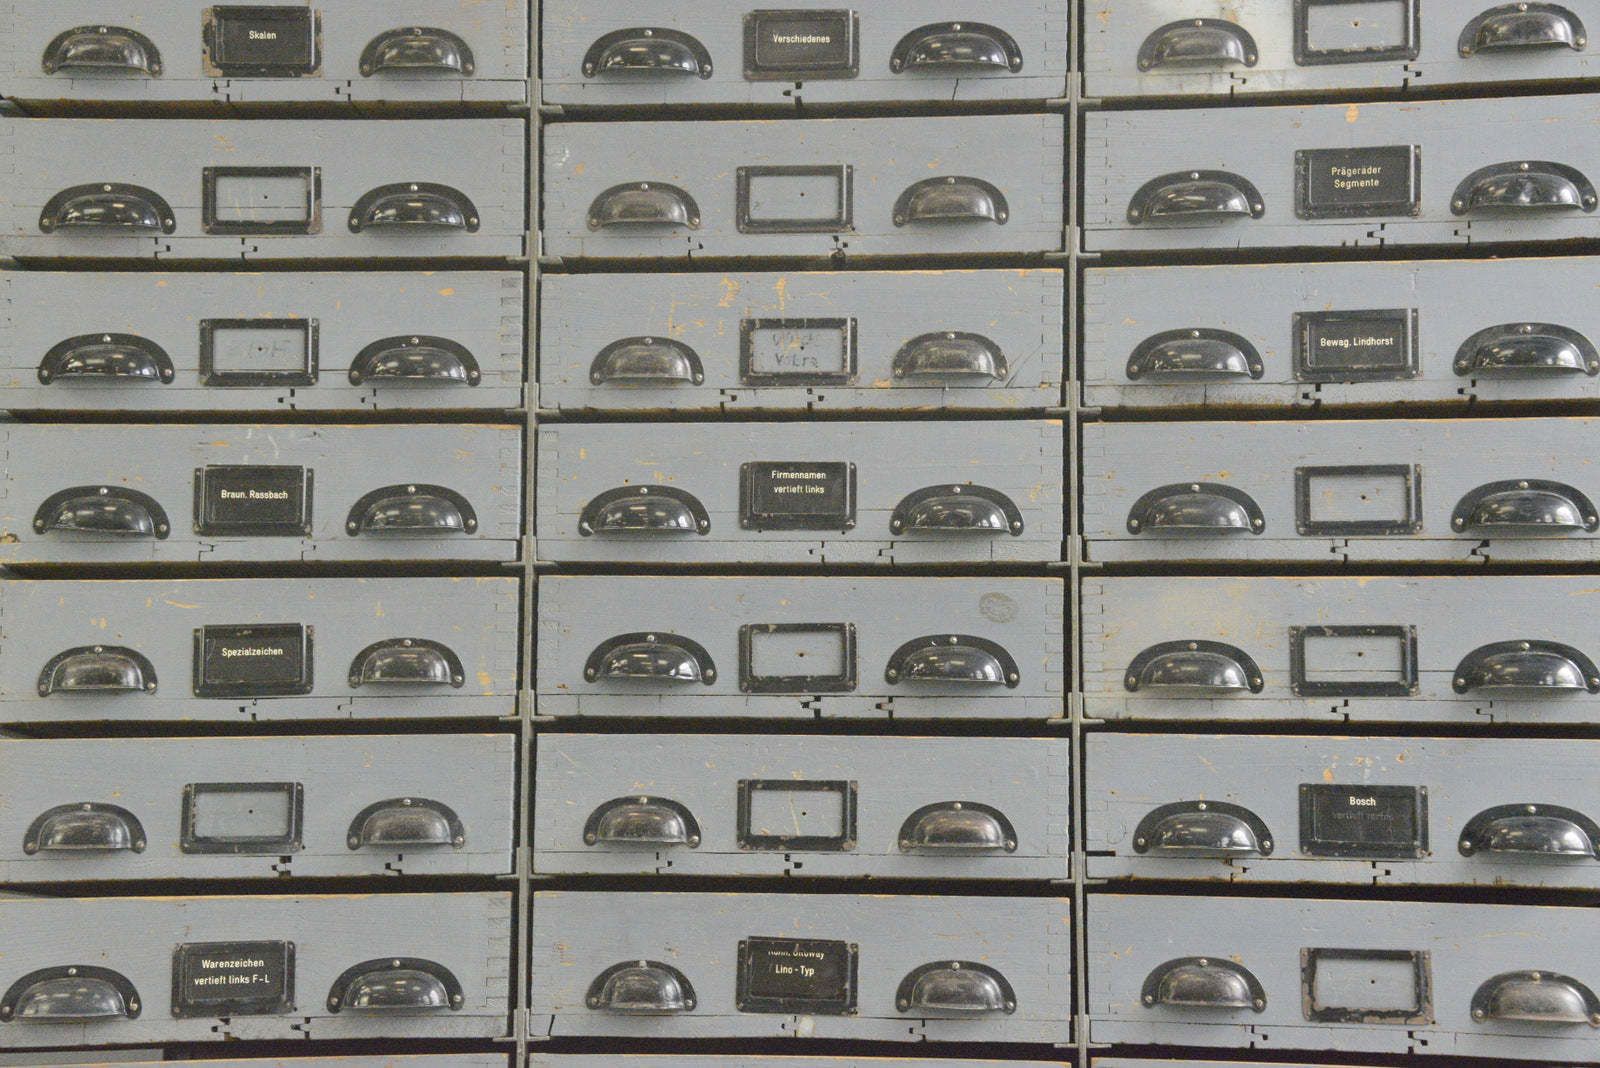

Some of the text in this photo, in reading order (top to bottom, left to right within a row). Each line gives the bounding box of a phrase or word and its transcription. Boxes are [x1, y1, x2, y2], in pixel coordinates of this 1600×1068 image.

[249, 29, 277, 40] Skalen
[773, 33, 831, 44] Verschiedenes
[1334, 178, 1380, 190] Segmente
[1353, 336, 1394, 346] Lindhorst
[772, 469, 827, 480] Firmennamen
[249, 489, 289, 500] Rassbach
[774, 484, 825, 494] vertieft links
[222, 647, 284, 658] Spezialzeichen
[1350, 795, 1377, 806] Bosch
[202, 957, 265, 969] Warenzeichen
[776, 964, 793, 975] Lino
[801, 965, 815, 978] Typ
[194, 975, 226, 986] vertieft
[229, 974, 250, 985] links
